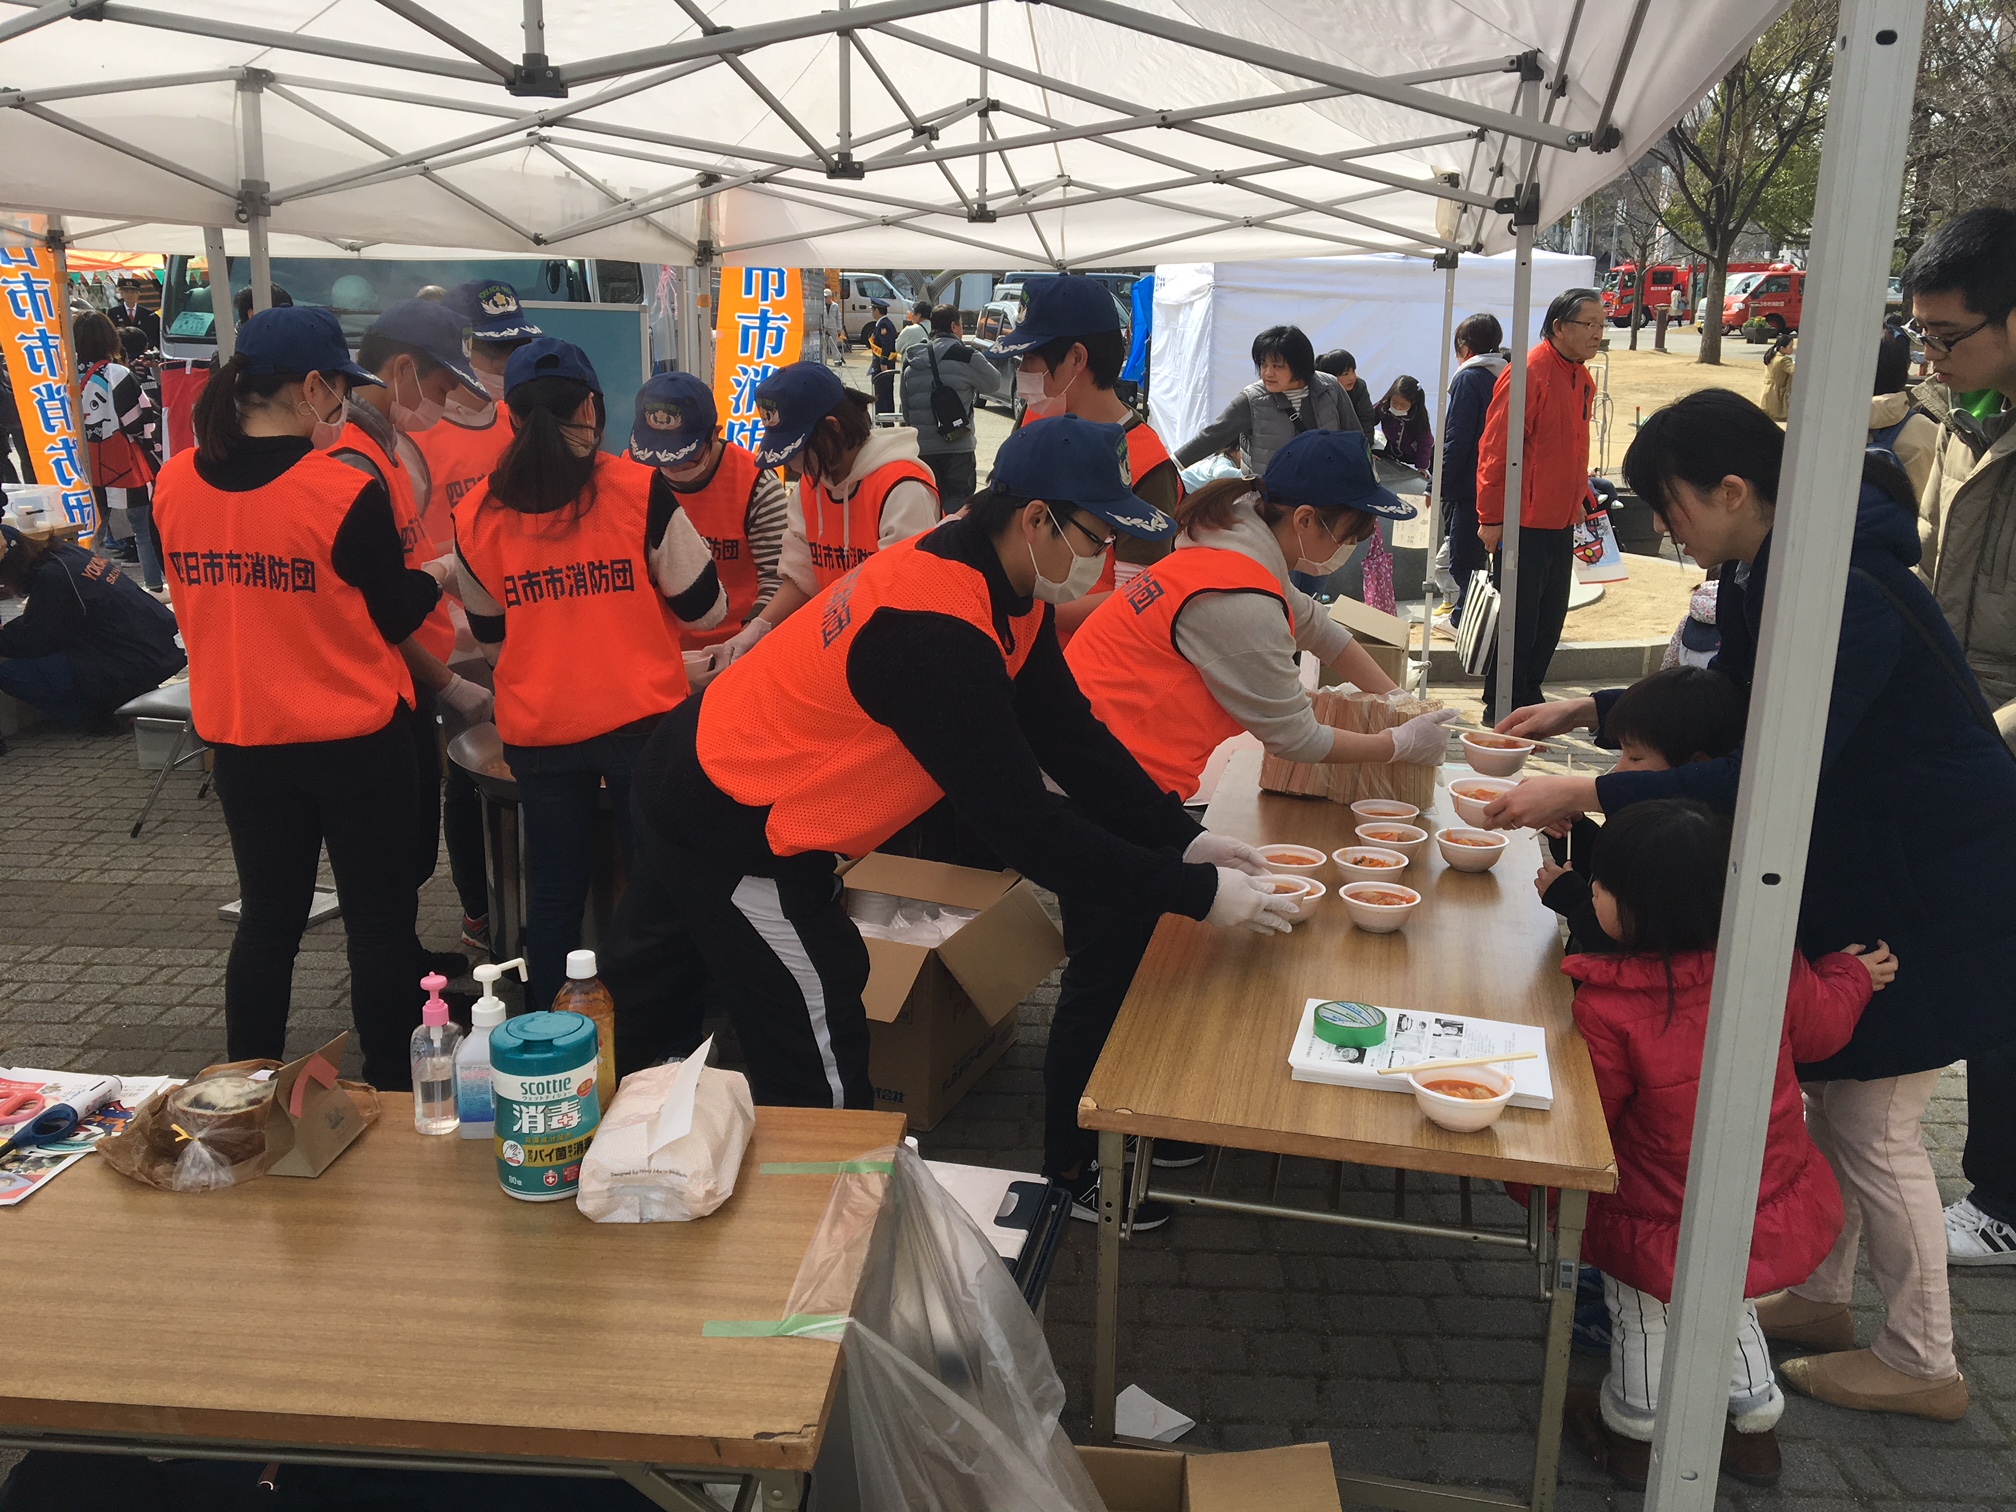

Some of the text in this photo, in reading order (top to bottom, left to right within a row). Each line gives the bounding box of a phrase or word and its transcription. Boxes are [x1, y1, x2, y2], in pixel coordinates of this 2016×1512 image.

[504, 559, 635, 608] 日市市消防団
[520, 1077, 573, 1096] scottie
[512, 1099, 582, 1134] 消毒
